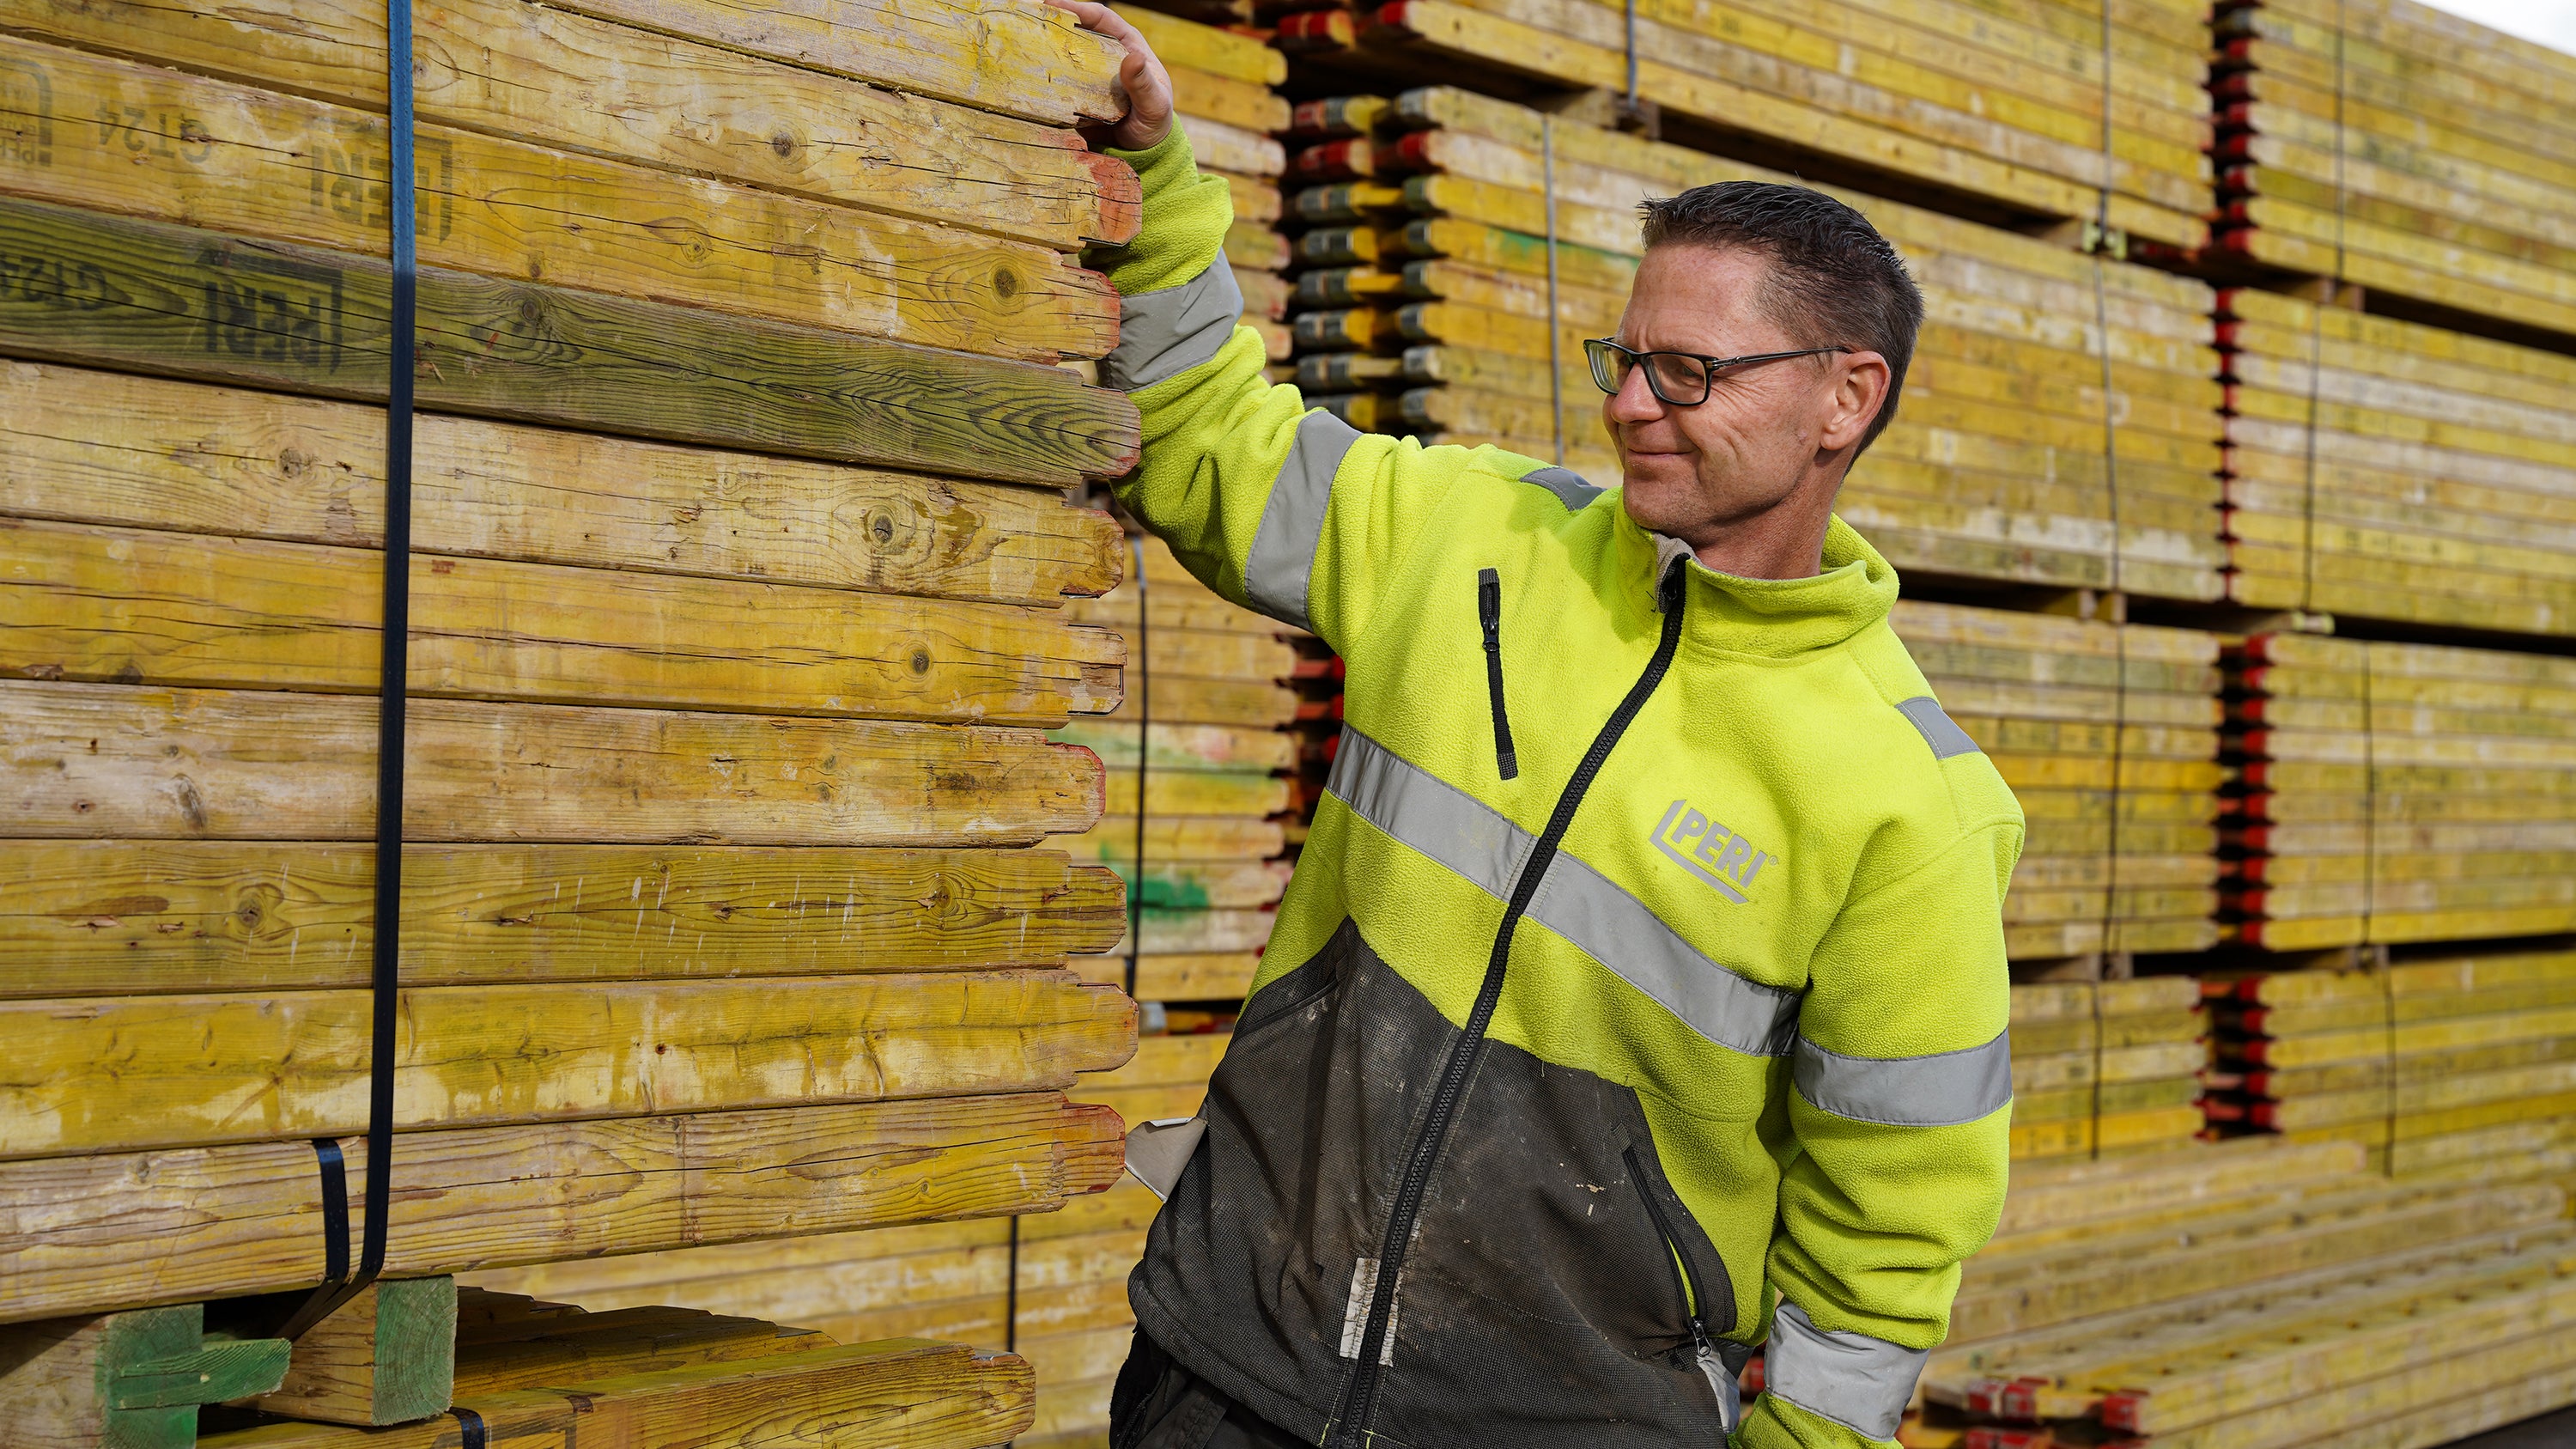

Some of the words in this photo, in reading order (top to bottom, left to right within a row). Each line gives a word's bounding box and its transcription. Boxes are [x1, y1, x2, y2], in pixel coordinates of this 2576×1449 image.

[94, 100, 212, 164] GT24
[205, 281, 320, 368] PERI
[1673, 807, 1768, 889] PERI
